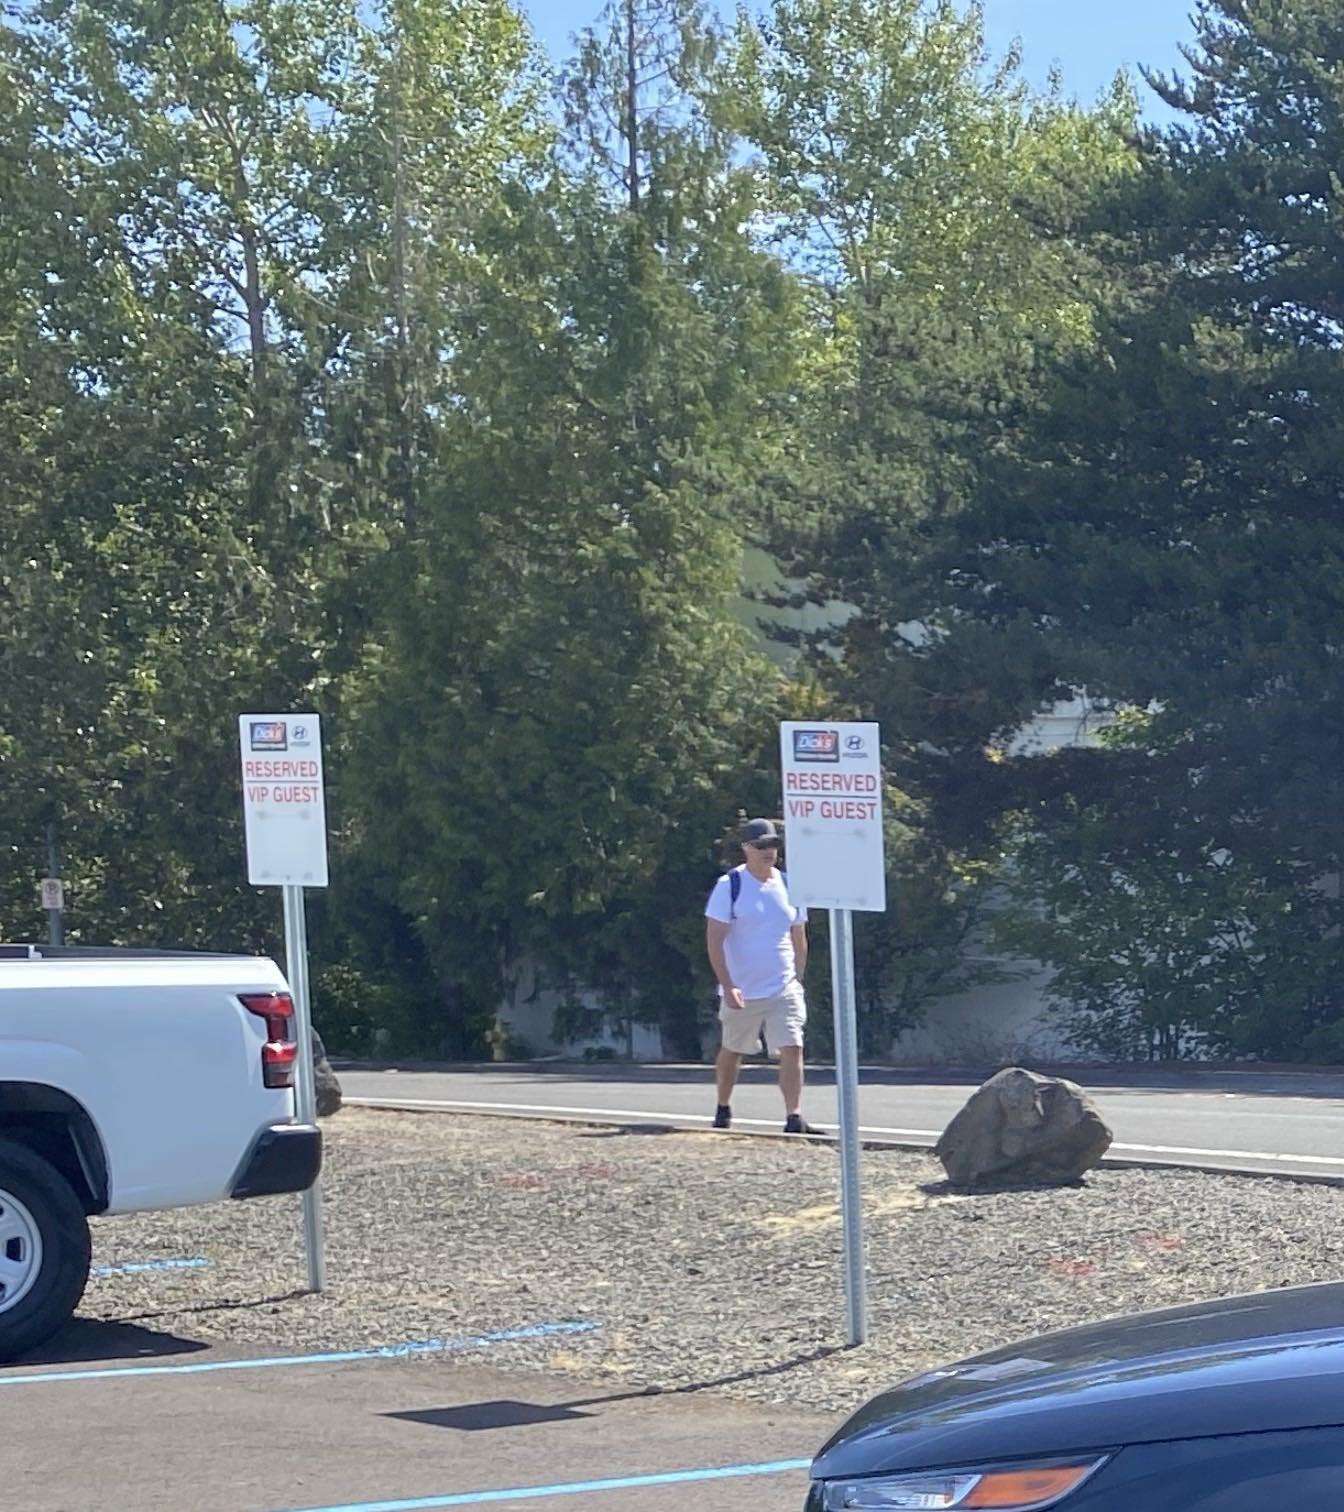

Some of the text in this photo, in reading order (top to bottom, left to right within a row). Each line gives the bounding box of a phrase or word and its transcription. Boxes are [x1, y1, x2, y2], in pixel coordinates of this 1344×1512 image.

[245, 761, 318, 778] RESERVED
[786, 773, 877, 792] RESERVED
[248, 786, 320, 803] VIP GUEST
[788, 800, 877, 820] VIP GUEST
